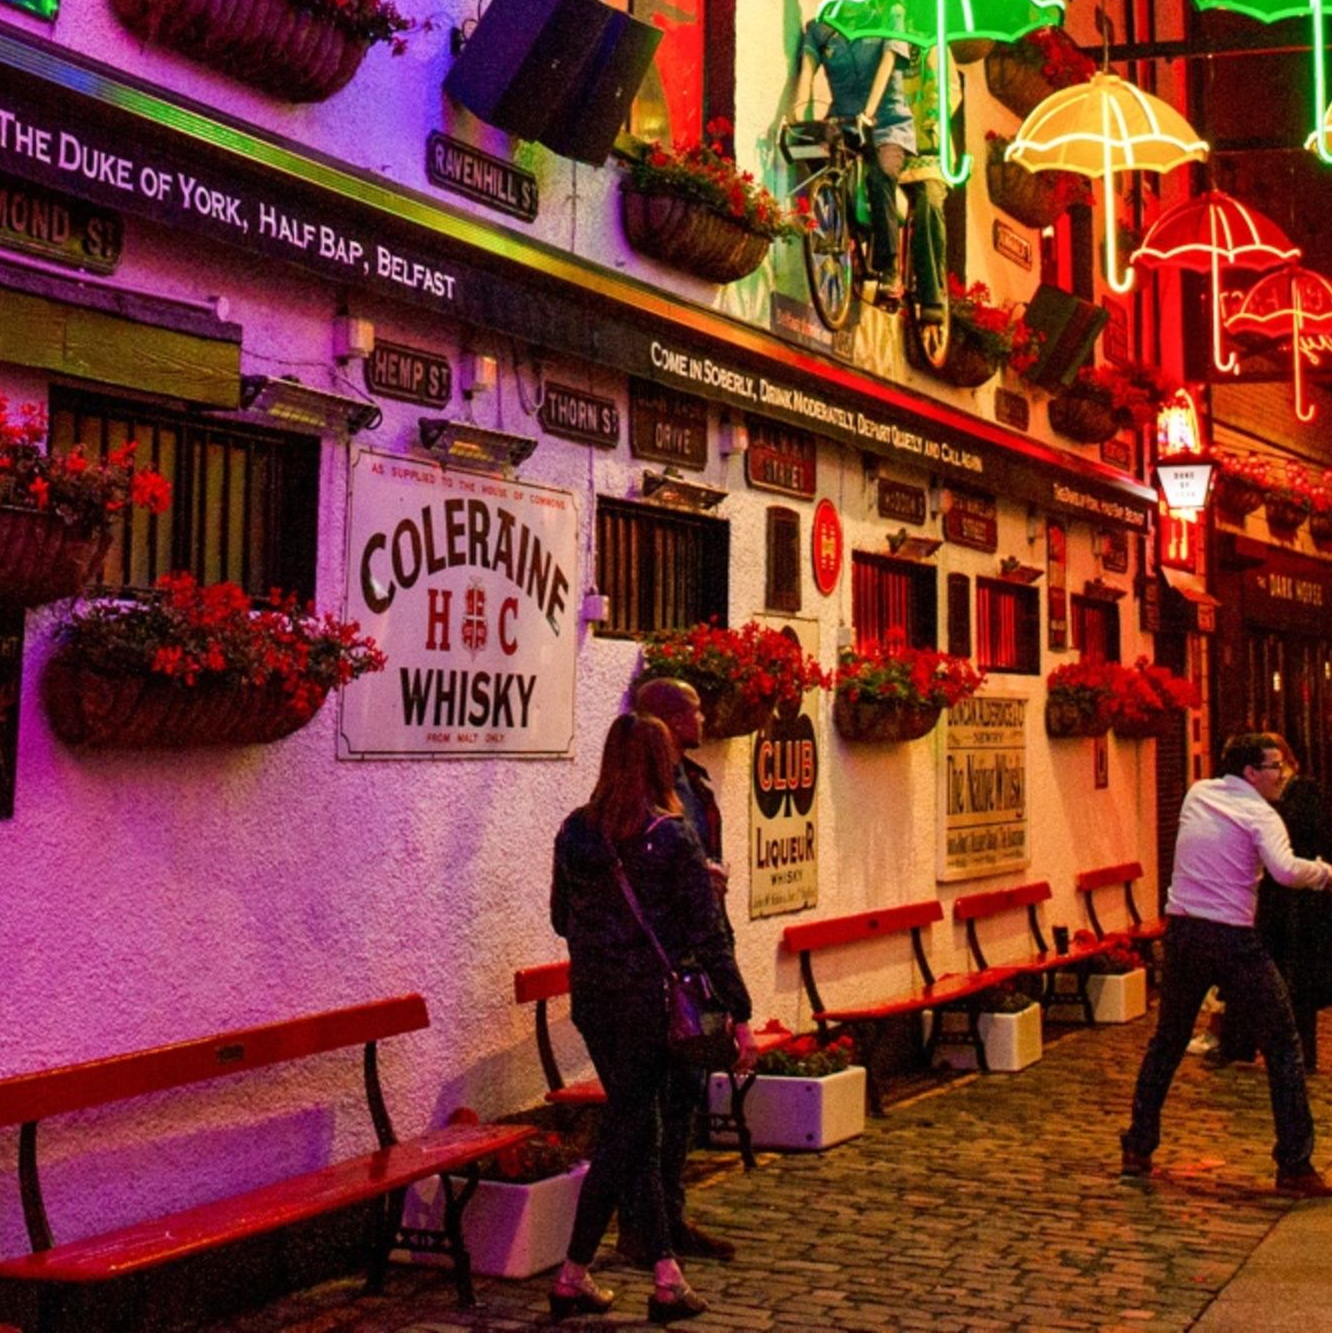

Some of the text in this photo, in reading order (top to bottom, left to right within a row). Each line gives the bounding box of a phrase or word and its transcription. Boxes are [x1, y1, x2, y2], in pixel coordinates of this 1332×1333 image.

[434, 142, 517, 202] RAVENHILL
[58, 132, 135, 192] DUKE
[377, 247, 457, 300] BELFAST
[375, 349, 424, 394] HEMP
[549, 392, 599, 432] THORN
[360, 497, 569, 637] COLERAINE
[426, 588, 519, 656] H C
[400, 667, 537, 729] WHISKY
[758, 739, 814, 792] CLUB
[756, 820, 815, 870] LIQUEUR
[770, 870, 803, 887] WHISKY
